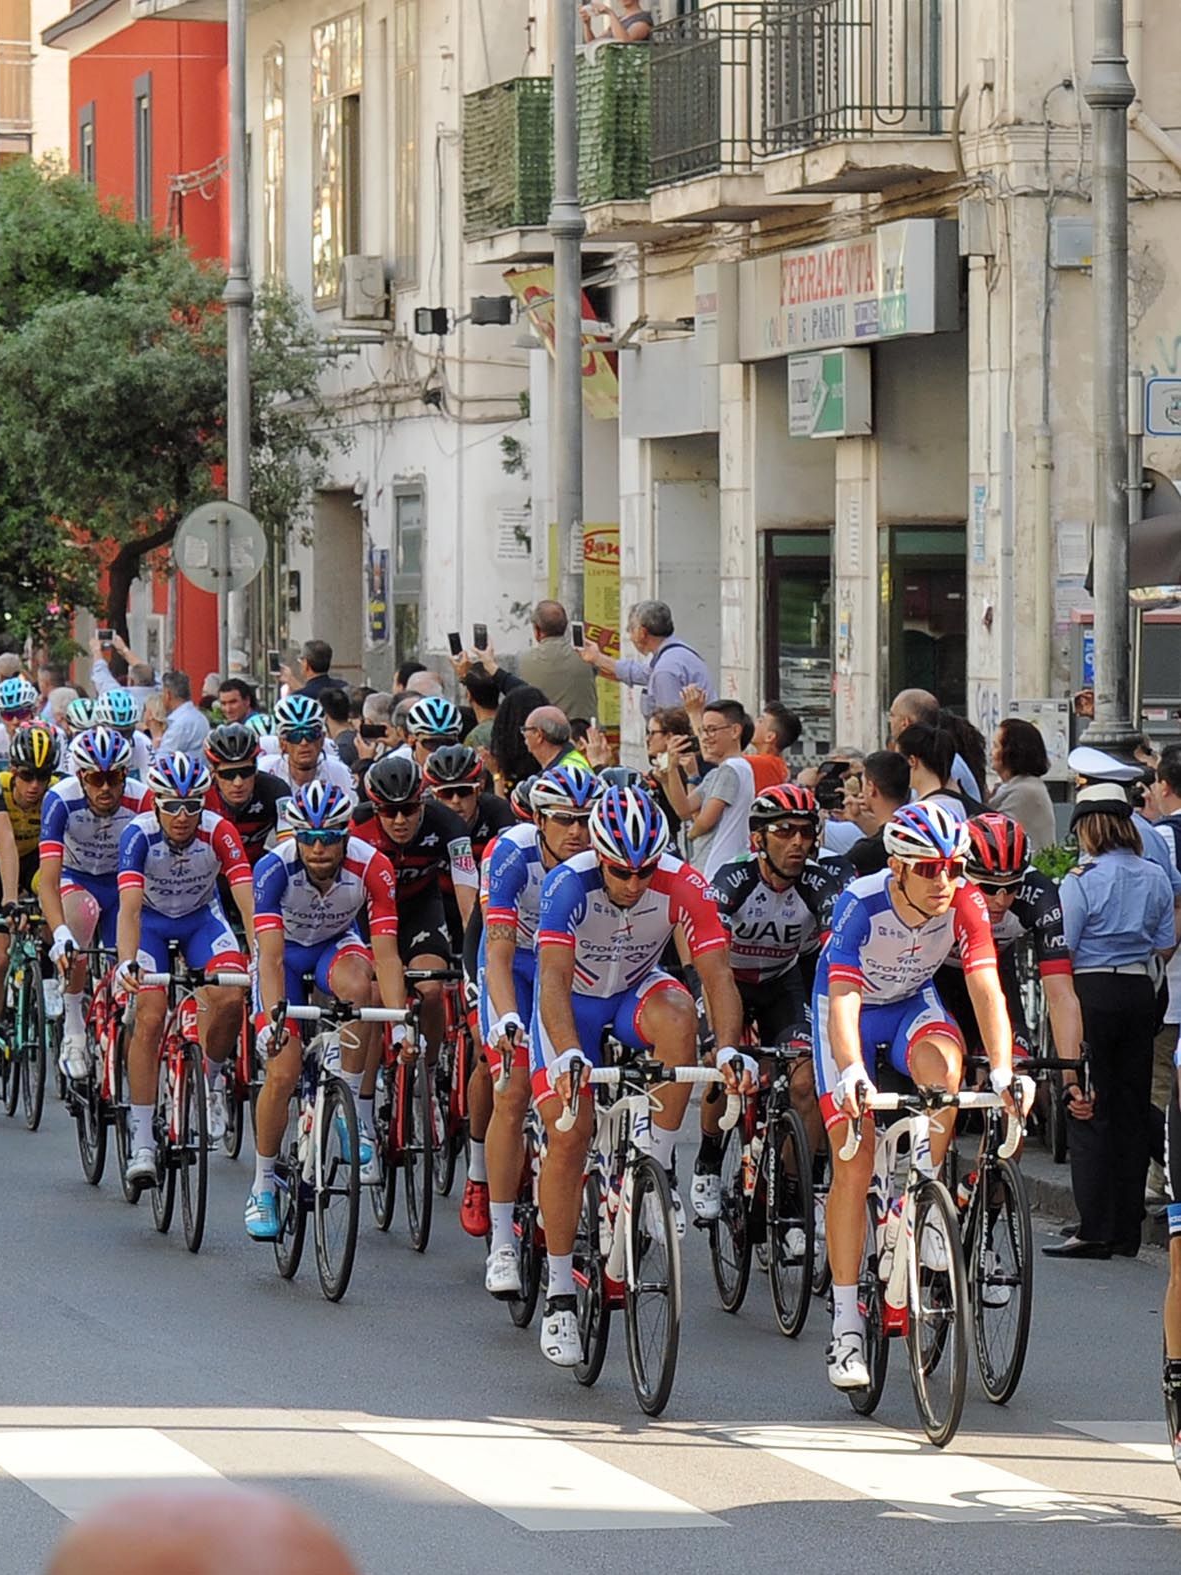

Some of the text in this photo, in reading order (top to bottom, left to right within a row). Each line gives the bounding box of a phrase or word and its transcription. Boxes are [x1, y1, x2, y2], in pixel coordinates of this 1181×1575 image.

[780, 243, 874, 306] FERRAMENTA
[812, 304, 846, 341] PARATI
[726, 867, 750, 889] UAE
[801, 871, 827, 892] UAE
[734, 921, 802, 943] UAE
[580, 939, 658, 952] Groupama
